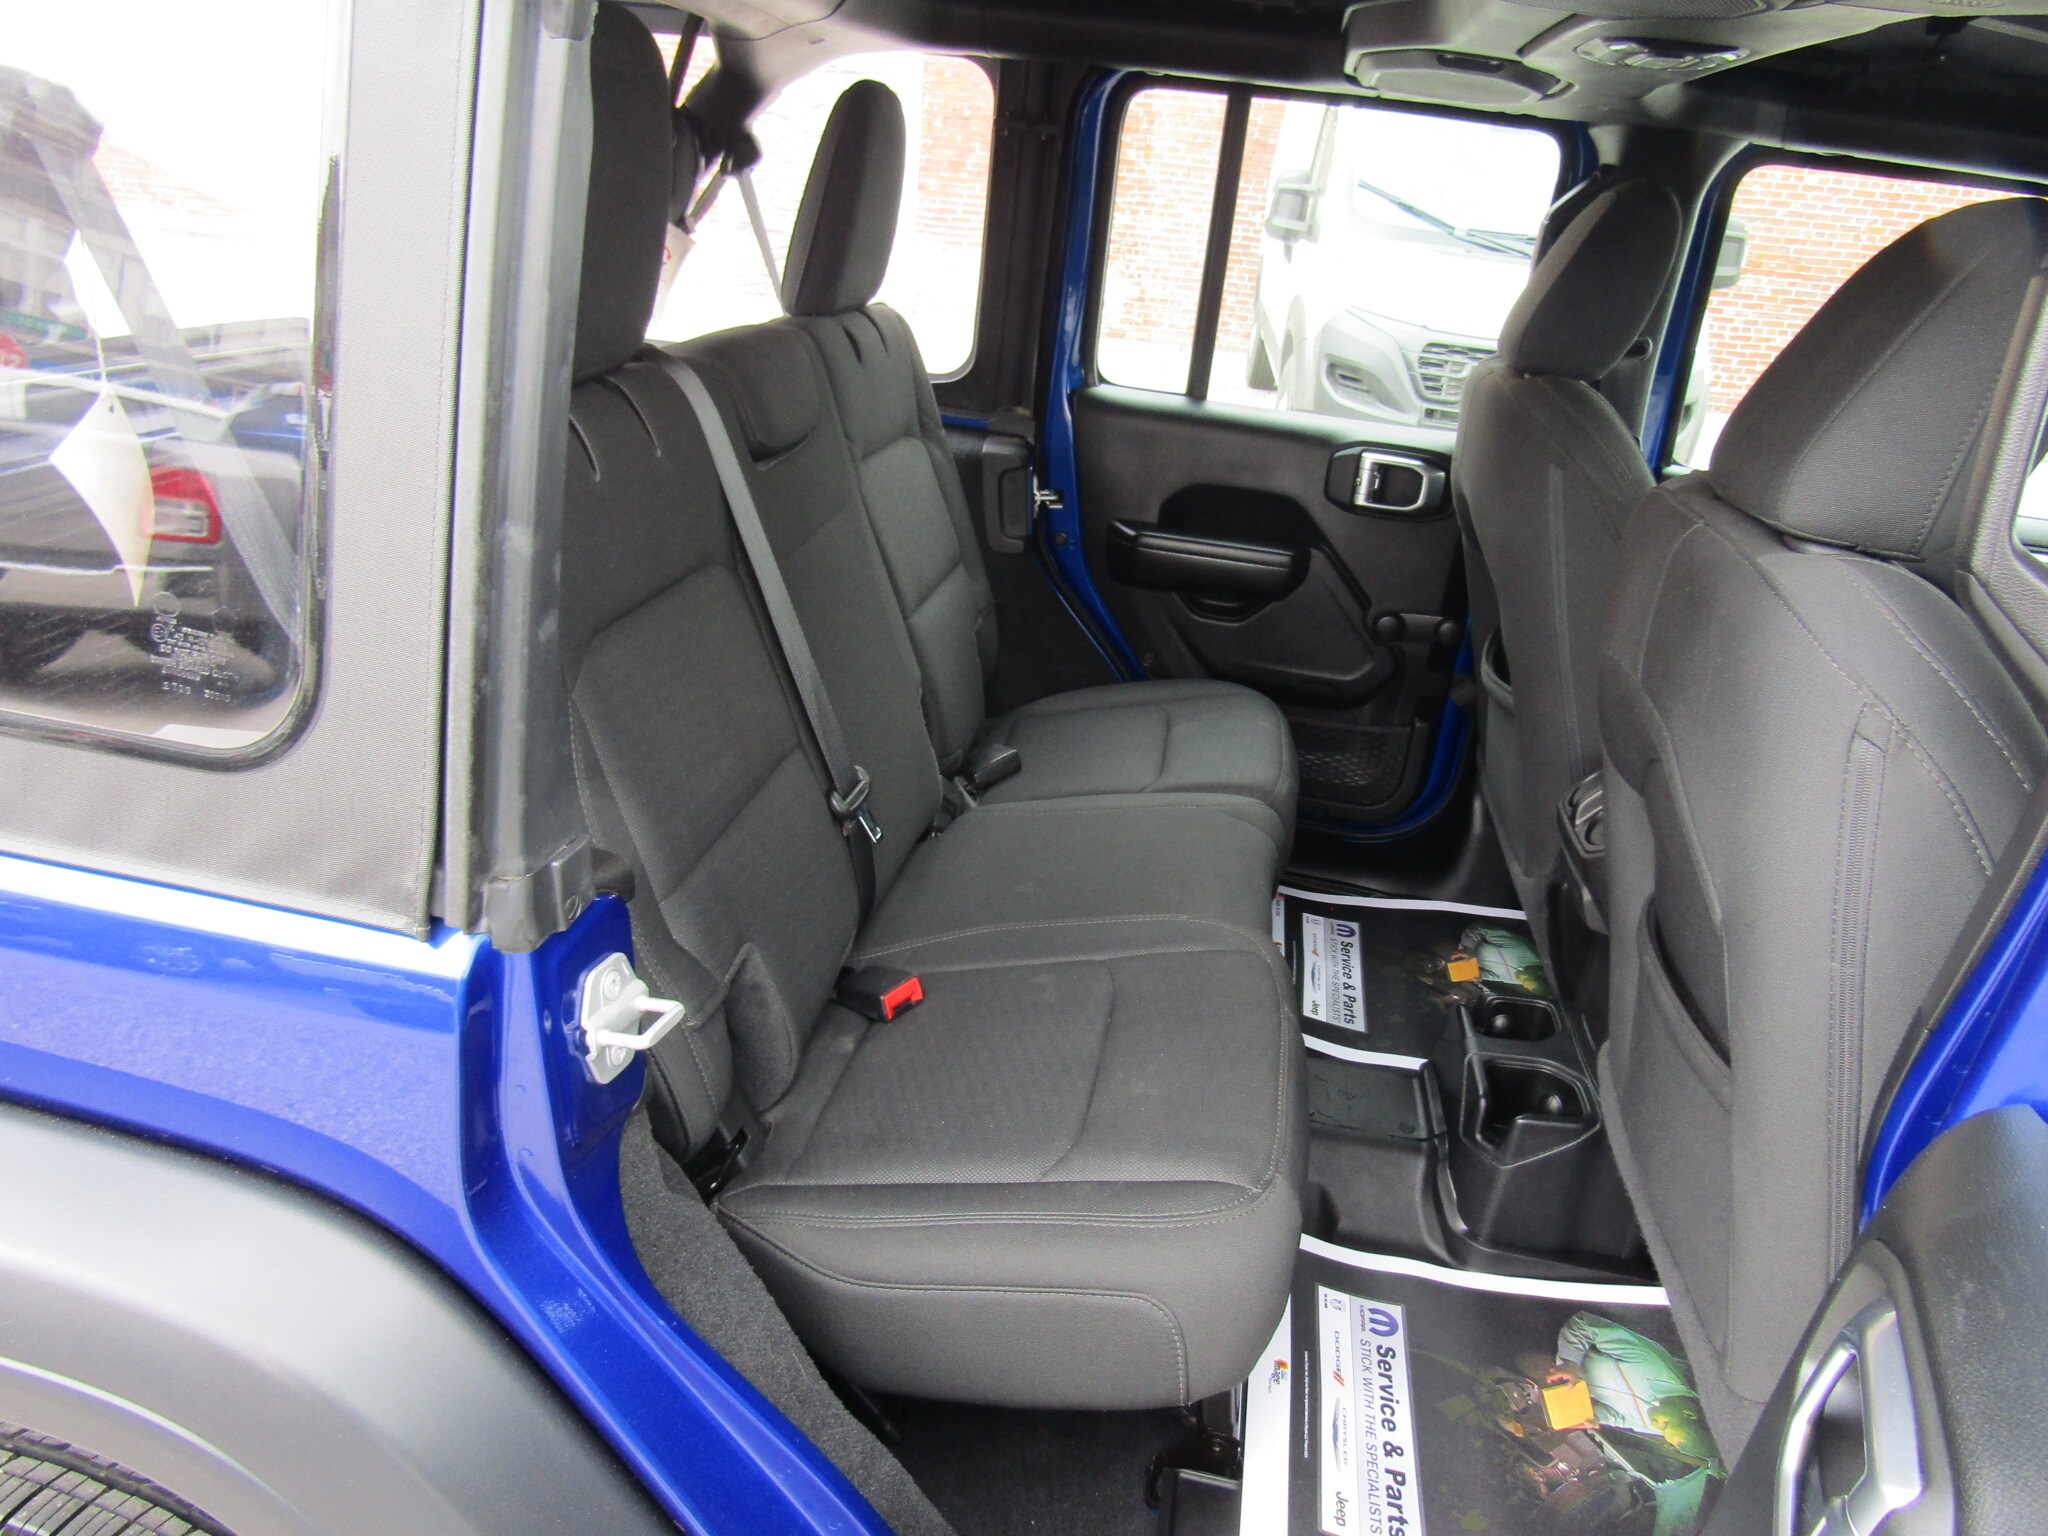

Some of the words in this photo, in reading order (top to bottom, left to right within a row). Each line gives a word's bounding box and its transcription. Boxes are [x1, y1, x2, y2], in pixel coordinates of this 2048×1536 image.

[1341, 941, 1354, 979] Service
[1342, 982, 1356, 990] &
[1343, 994, 1357, 1024] Parts
[1360, 1339, 1373, 1375] STICK
[1362, 1377, 1375, 1410] WITH
[1376, 1344, 1399, 1432] Service
[1364, 1413, 1376, 1440] THE
[1382, 1440, 1404, 1458] &
[1365, 1442, 1383, 1534] SPECIALISTS
[1333, 1491, 1349, 1527] Jeep
